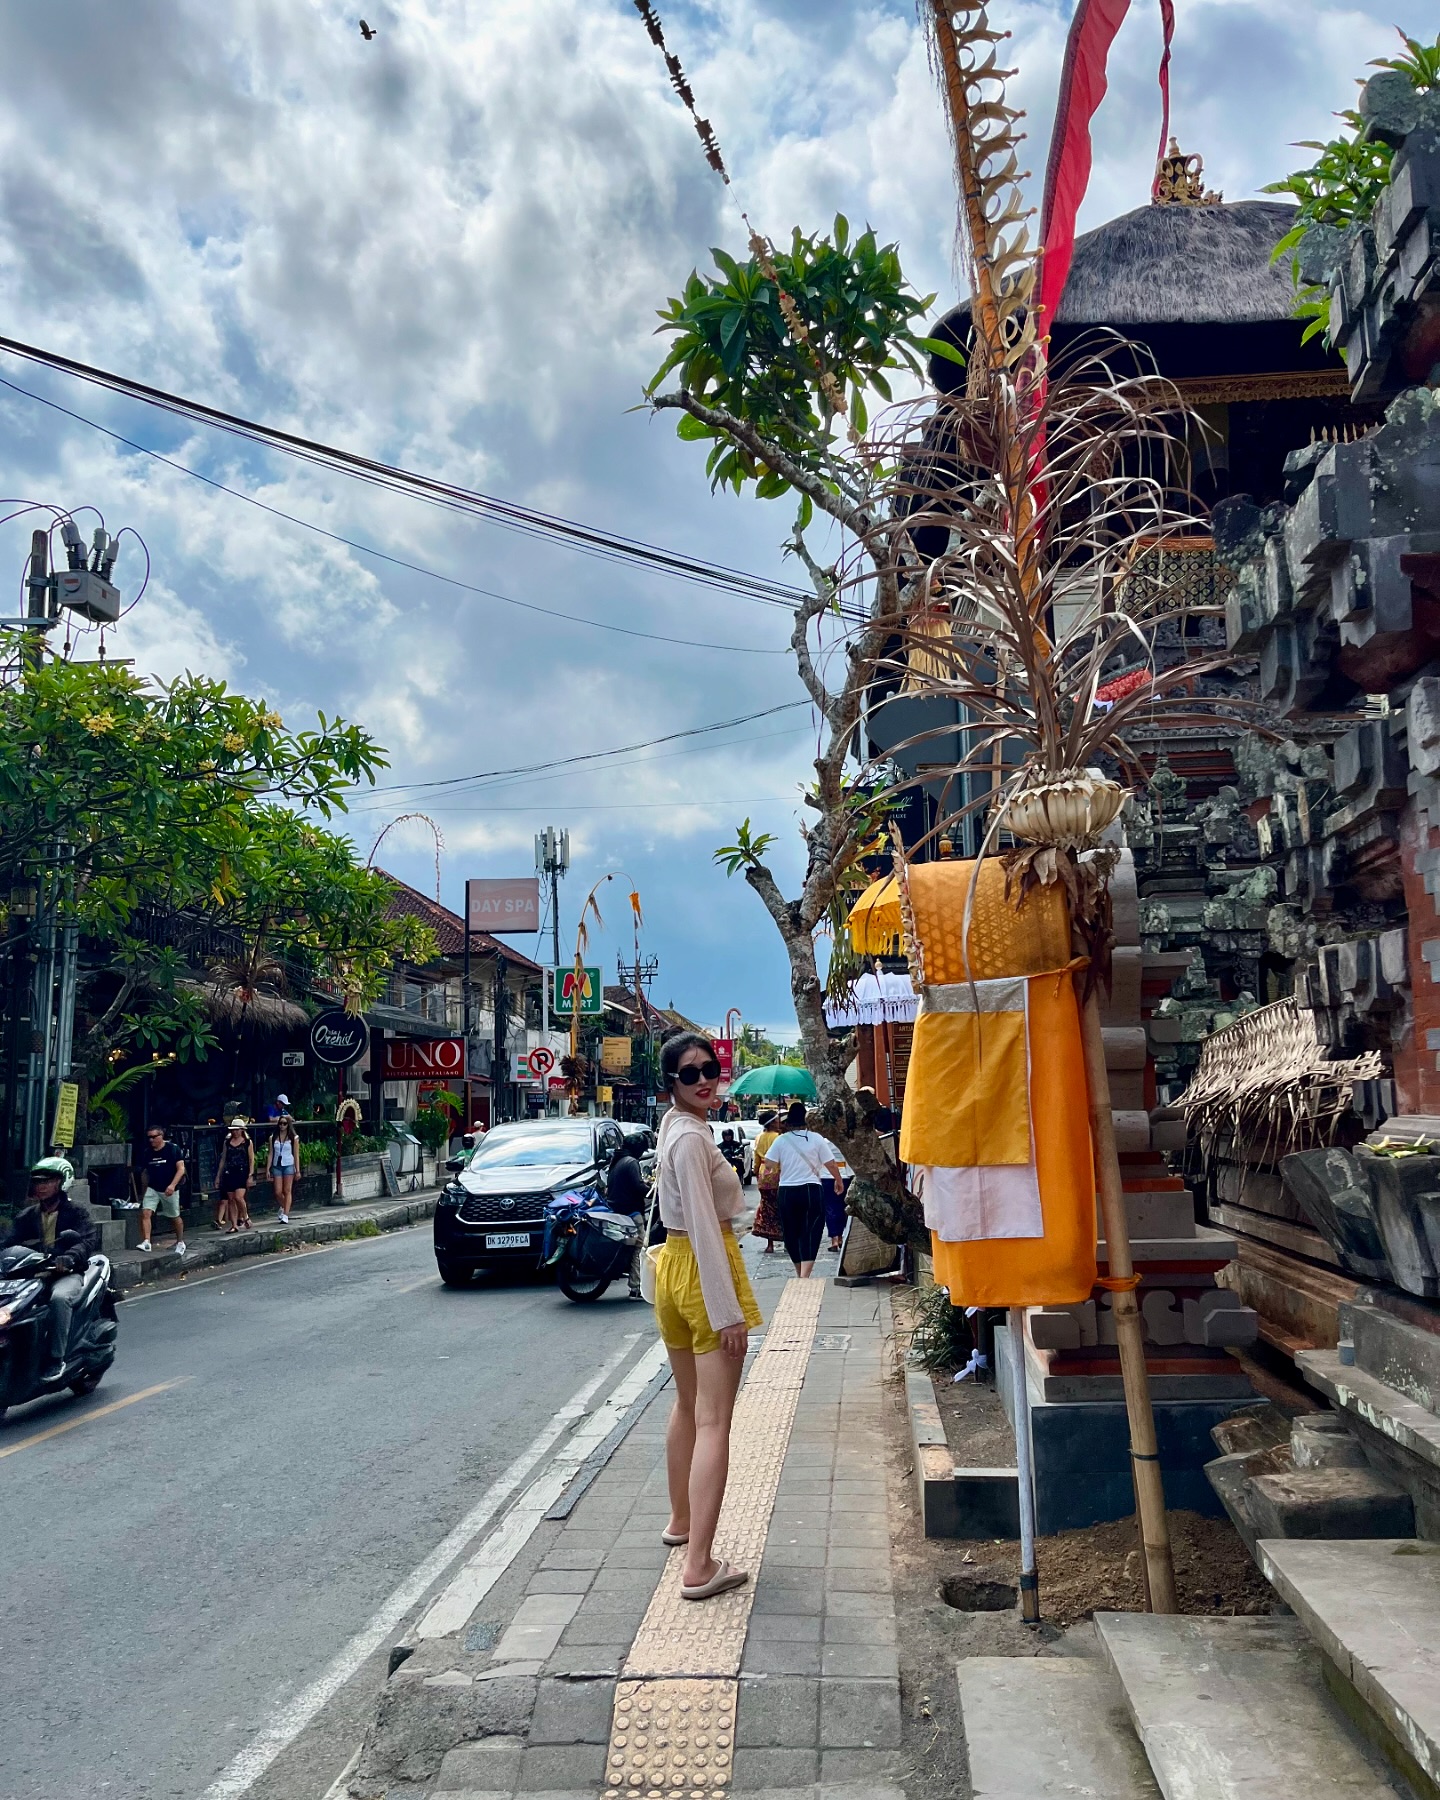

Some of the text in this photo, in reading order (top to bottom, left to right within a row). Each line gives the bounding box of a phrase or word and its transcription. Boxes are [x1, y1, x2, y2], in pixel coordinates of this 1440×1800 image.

[471, 900, 535, 913] DAY SPA
[562, 1000, 593, 1008] MRT
[315, 1025, 355, 1046] Orchid
[386, 1041, 461, 1069] UNO
[487, 1236, 496, 1246] DK
